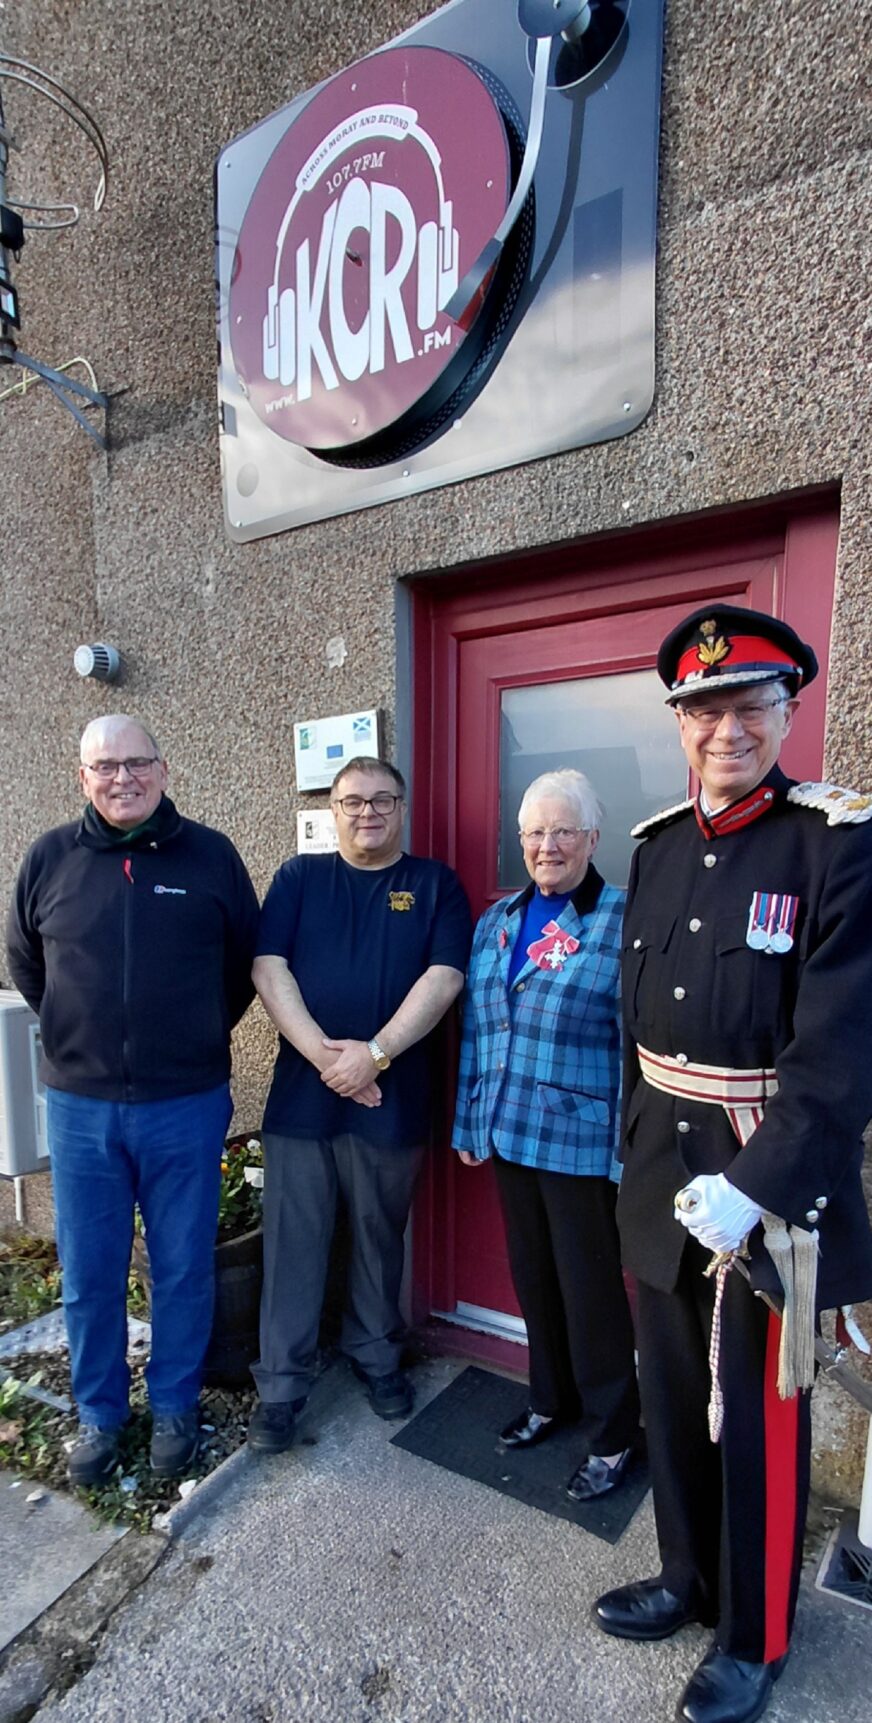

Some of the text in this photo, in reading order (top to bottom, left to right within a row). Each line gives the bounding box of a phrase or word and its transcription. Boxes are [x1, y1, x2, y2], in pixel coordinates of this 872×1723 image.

[302, 114, 409, 185] ACROSS MORAY AND BEYOND
[326, 151, 386, 194] 107.7FM
[296, 177, 416, 402] KCR
